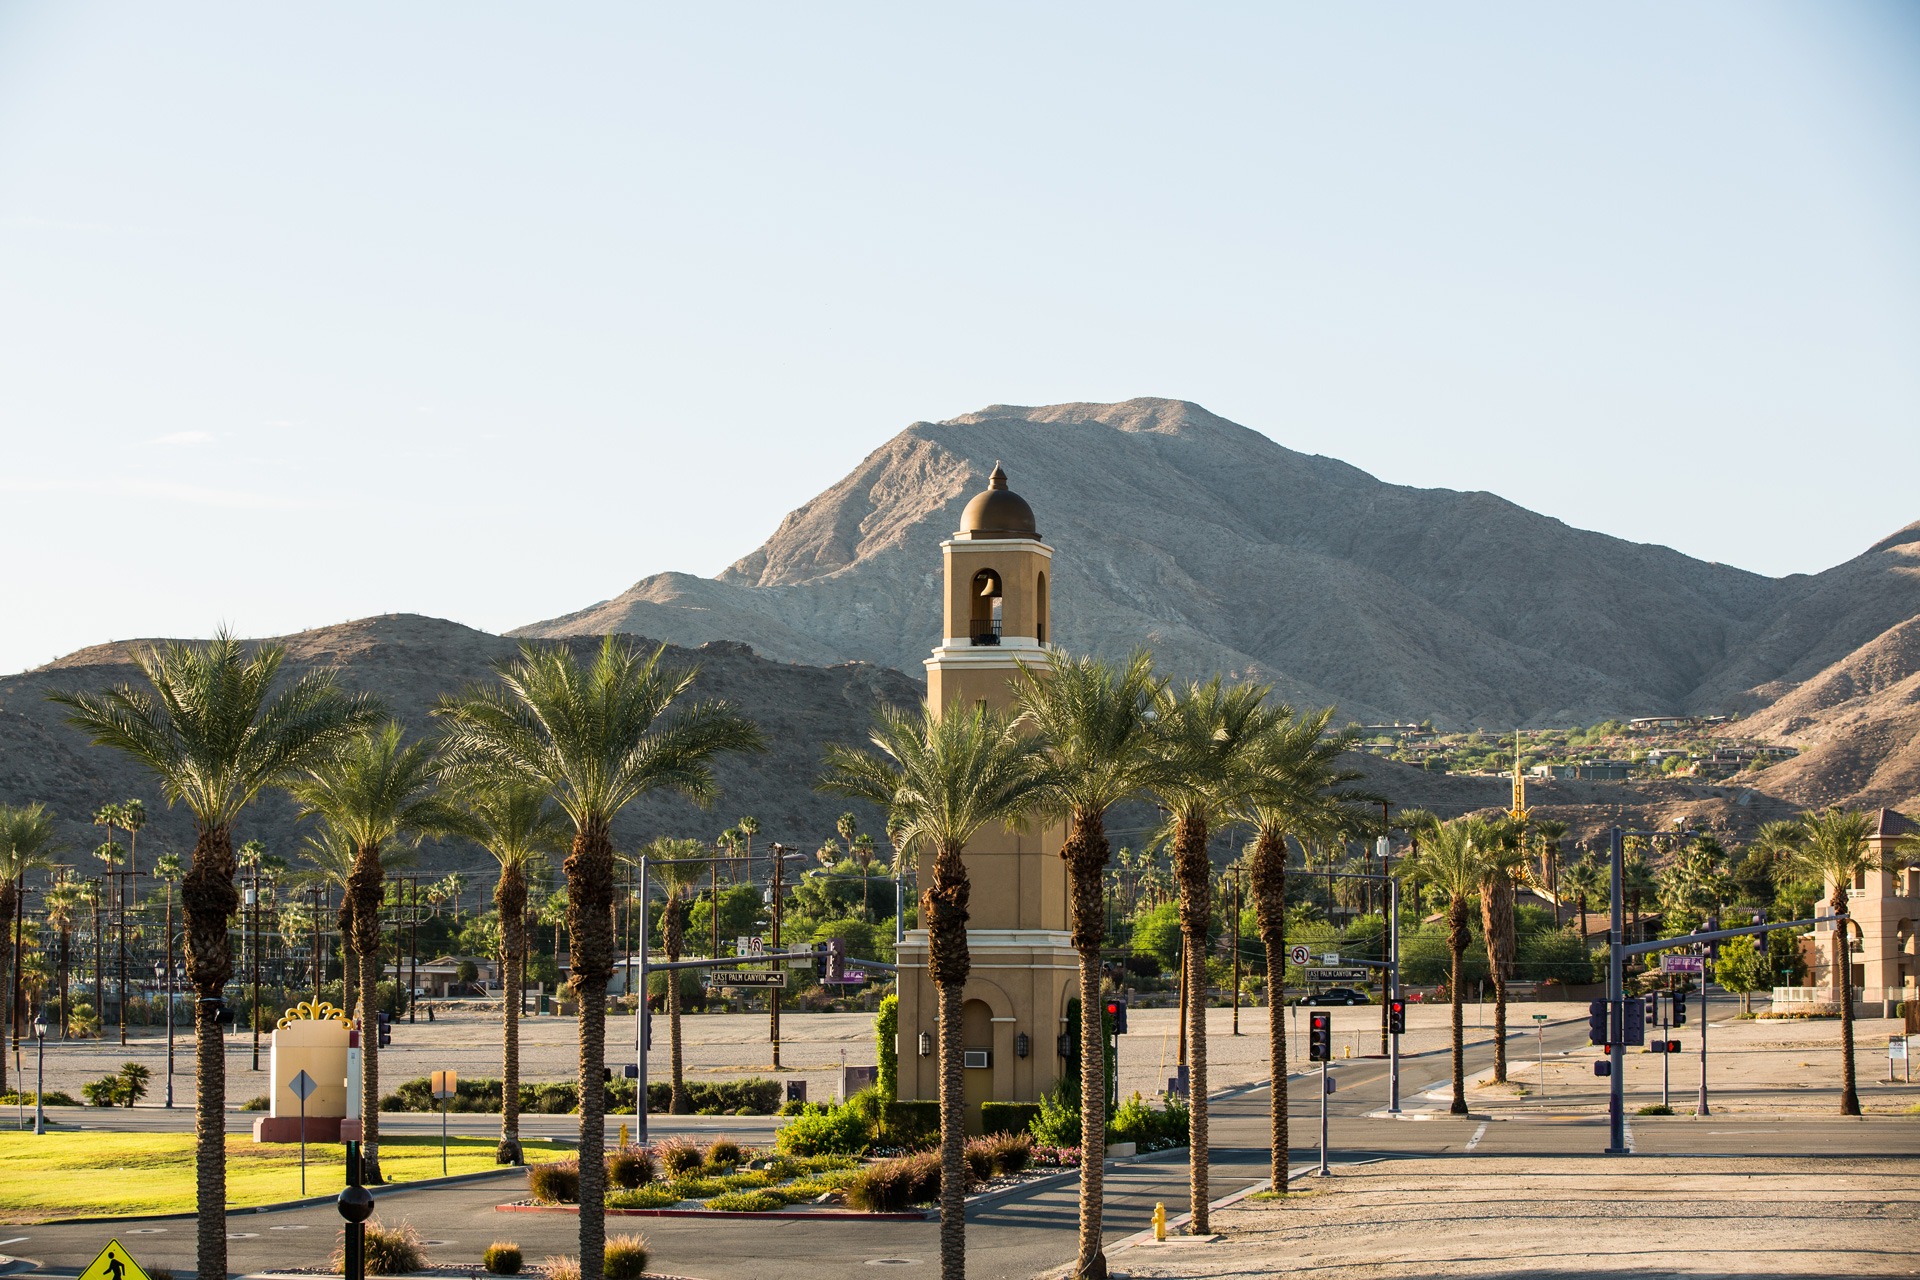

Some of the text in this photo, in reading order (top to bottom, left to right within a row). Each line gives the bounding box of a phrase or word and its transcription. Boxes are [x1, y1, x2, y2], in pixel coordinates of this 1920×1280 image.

[714, 973, 767, 981] EAST PALM CANYON
